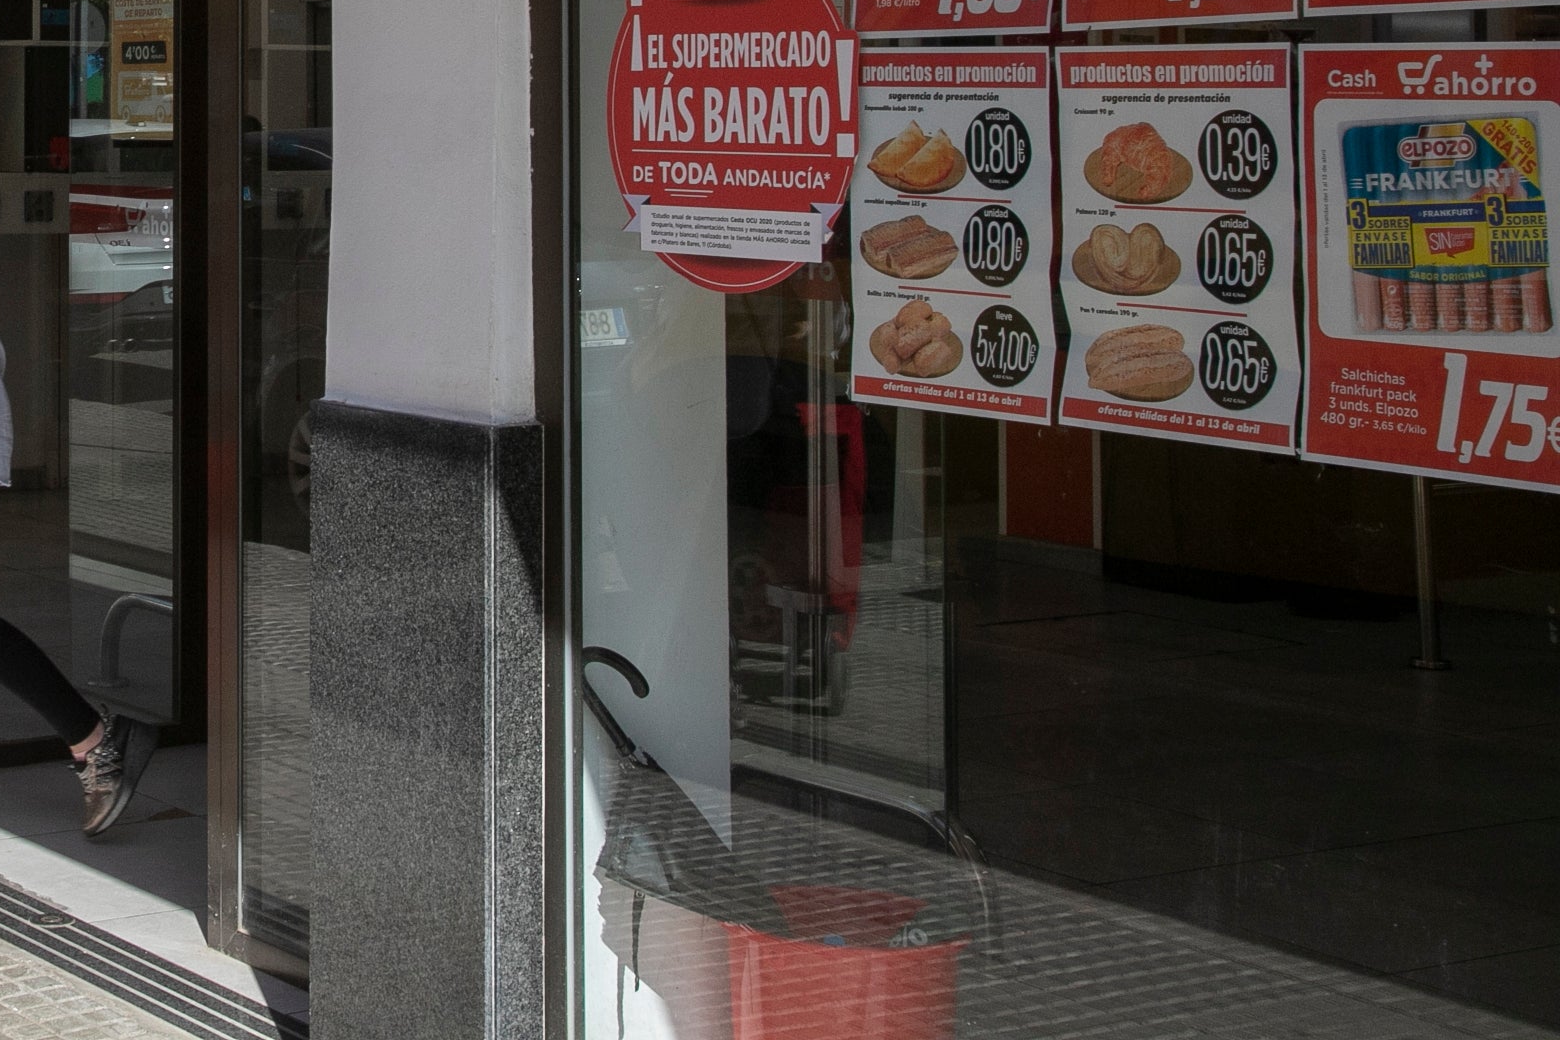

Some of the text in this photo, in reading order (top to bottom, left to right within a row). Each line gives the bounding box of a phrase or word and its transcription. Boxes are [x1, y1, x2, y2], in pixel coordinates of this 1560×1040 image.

[134, 7, 163, 17] REPARTO
[671, 30, 831, 69] SUPERMERCADO
[862, 62, 1037, 84] productos en promoción
[1070, 60, 1275, 85] productos en promoción
[1327, 69, 1538, 96] Cash ahorro
[632, 71, 696, 143] MÁS
[888, 92, 999, 102] sugerencia de presentación
[1101, 93, 1231, 104] sugerencia de presentación
[985, 111, 1010, 120] unidad
[1222, 114, 1252, 124] unidad
[1482, 121, 1537, 174] GRATIS
[632, 165, 654, 183] DE
[657, 161, 719, 186] TODA
[1365, 168, 1515, 192] FRANKFURT
[984, 209, 1009, 219] unidad
[1351, 200, 1409, 229] 3 SOBRES
[1422, 208, 1473, 218] FRANKFURT
[1487, 196, 1548, 227] 3 SOBRE
[1219, 218, 1249, 229] unidad
[1492, 229, 1548, 240] ENVASE
[1356, 231, 1407, 242] ENVASE
[1354, 243, 1411, 266] FAMILIAR
[1409, 269, 1487, 281] SABOR ORIGINAL
[995, 310, 1013, 321] lleve
[1219, 325, 1249, 336] unidad
[1341, 367, 1406, 386] Salchichas
[882, 381, 1022, 407] ofertas válidas del 1 al 13 de abril
[1330, 381, 1417, 403] frankfurt pack
[1328, 396, 1419, 419] 3 unds. Elpozo
[1097, 405, 1261, 435] ofertas válidas del 1 al 13 de abril
[1319, 411, 1346, 425] 480
[1396, 421, 1427, 436] €/kilo
